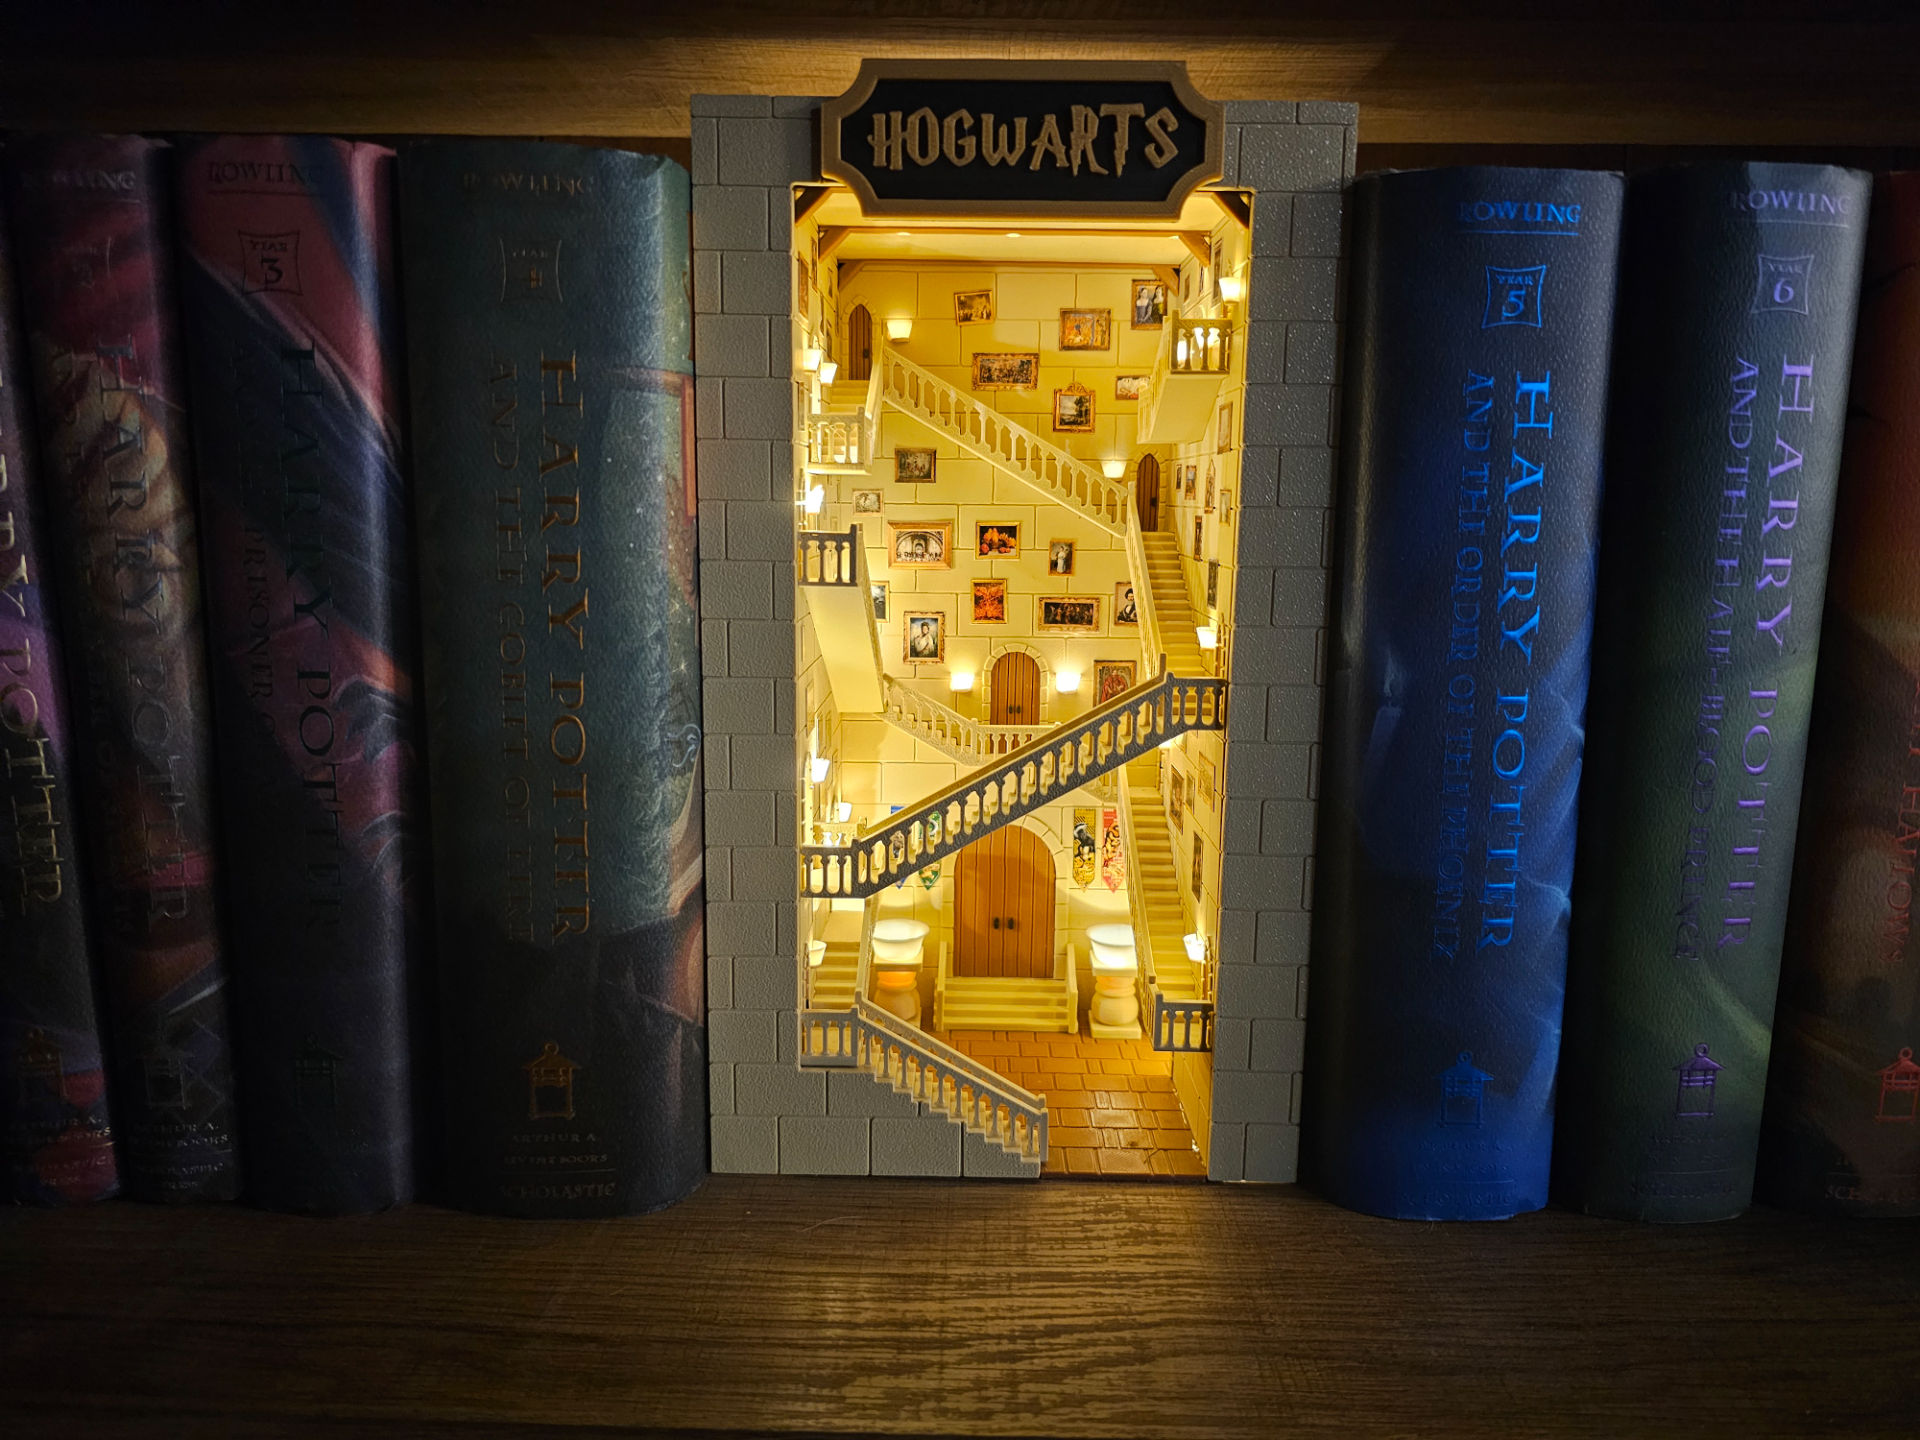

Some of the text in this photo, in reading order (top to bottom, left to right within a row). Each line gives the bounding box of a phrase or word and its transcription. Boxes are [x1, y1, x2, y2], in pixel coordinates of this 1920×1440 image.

[867, 103, 1180, 178] HOGWARTS
[1455, 200, 1581, 225] ROWLING
[260, 253, 284, 286] 3
[1496, 274, 1534, 286] YEAR
[1501, 286, 1526, 319] 5
[1773, 277, 1795, 304] 6
[1462, 368, 1495, 452] AND
[1730, 356, 1759, 450] AND
[1458, 461, 1492, 537] THE
[1716, 456, 1751, 546] THE
[539, 347, 590, 937] HARRY POTTER
[1447, 546, 1484, 666] ORDER
[1475, 369, 1553, 958] HARRY POTTER
[1716, 353, 1814, 953] HARRY POTTER
[1448, 674, 1476, 720] OF
